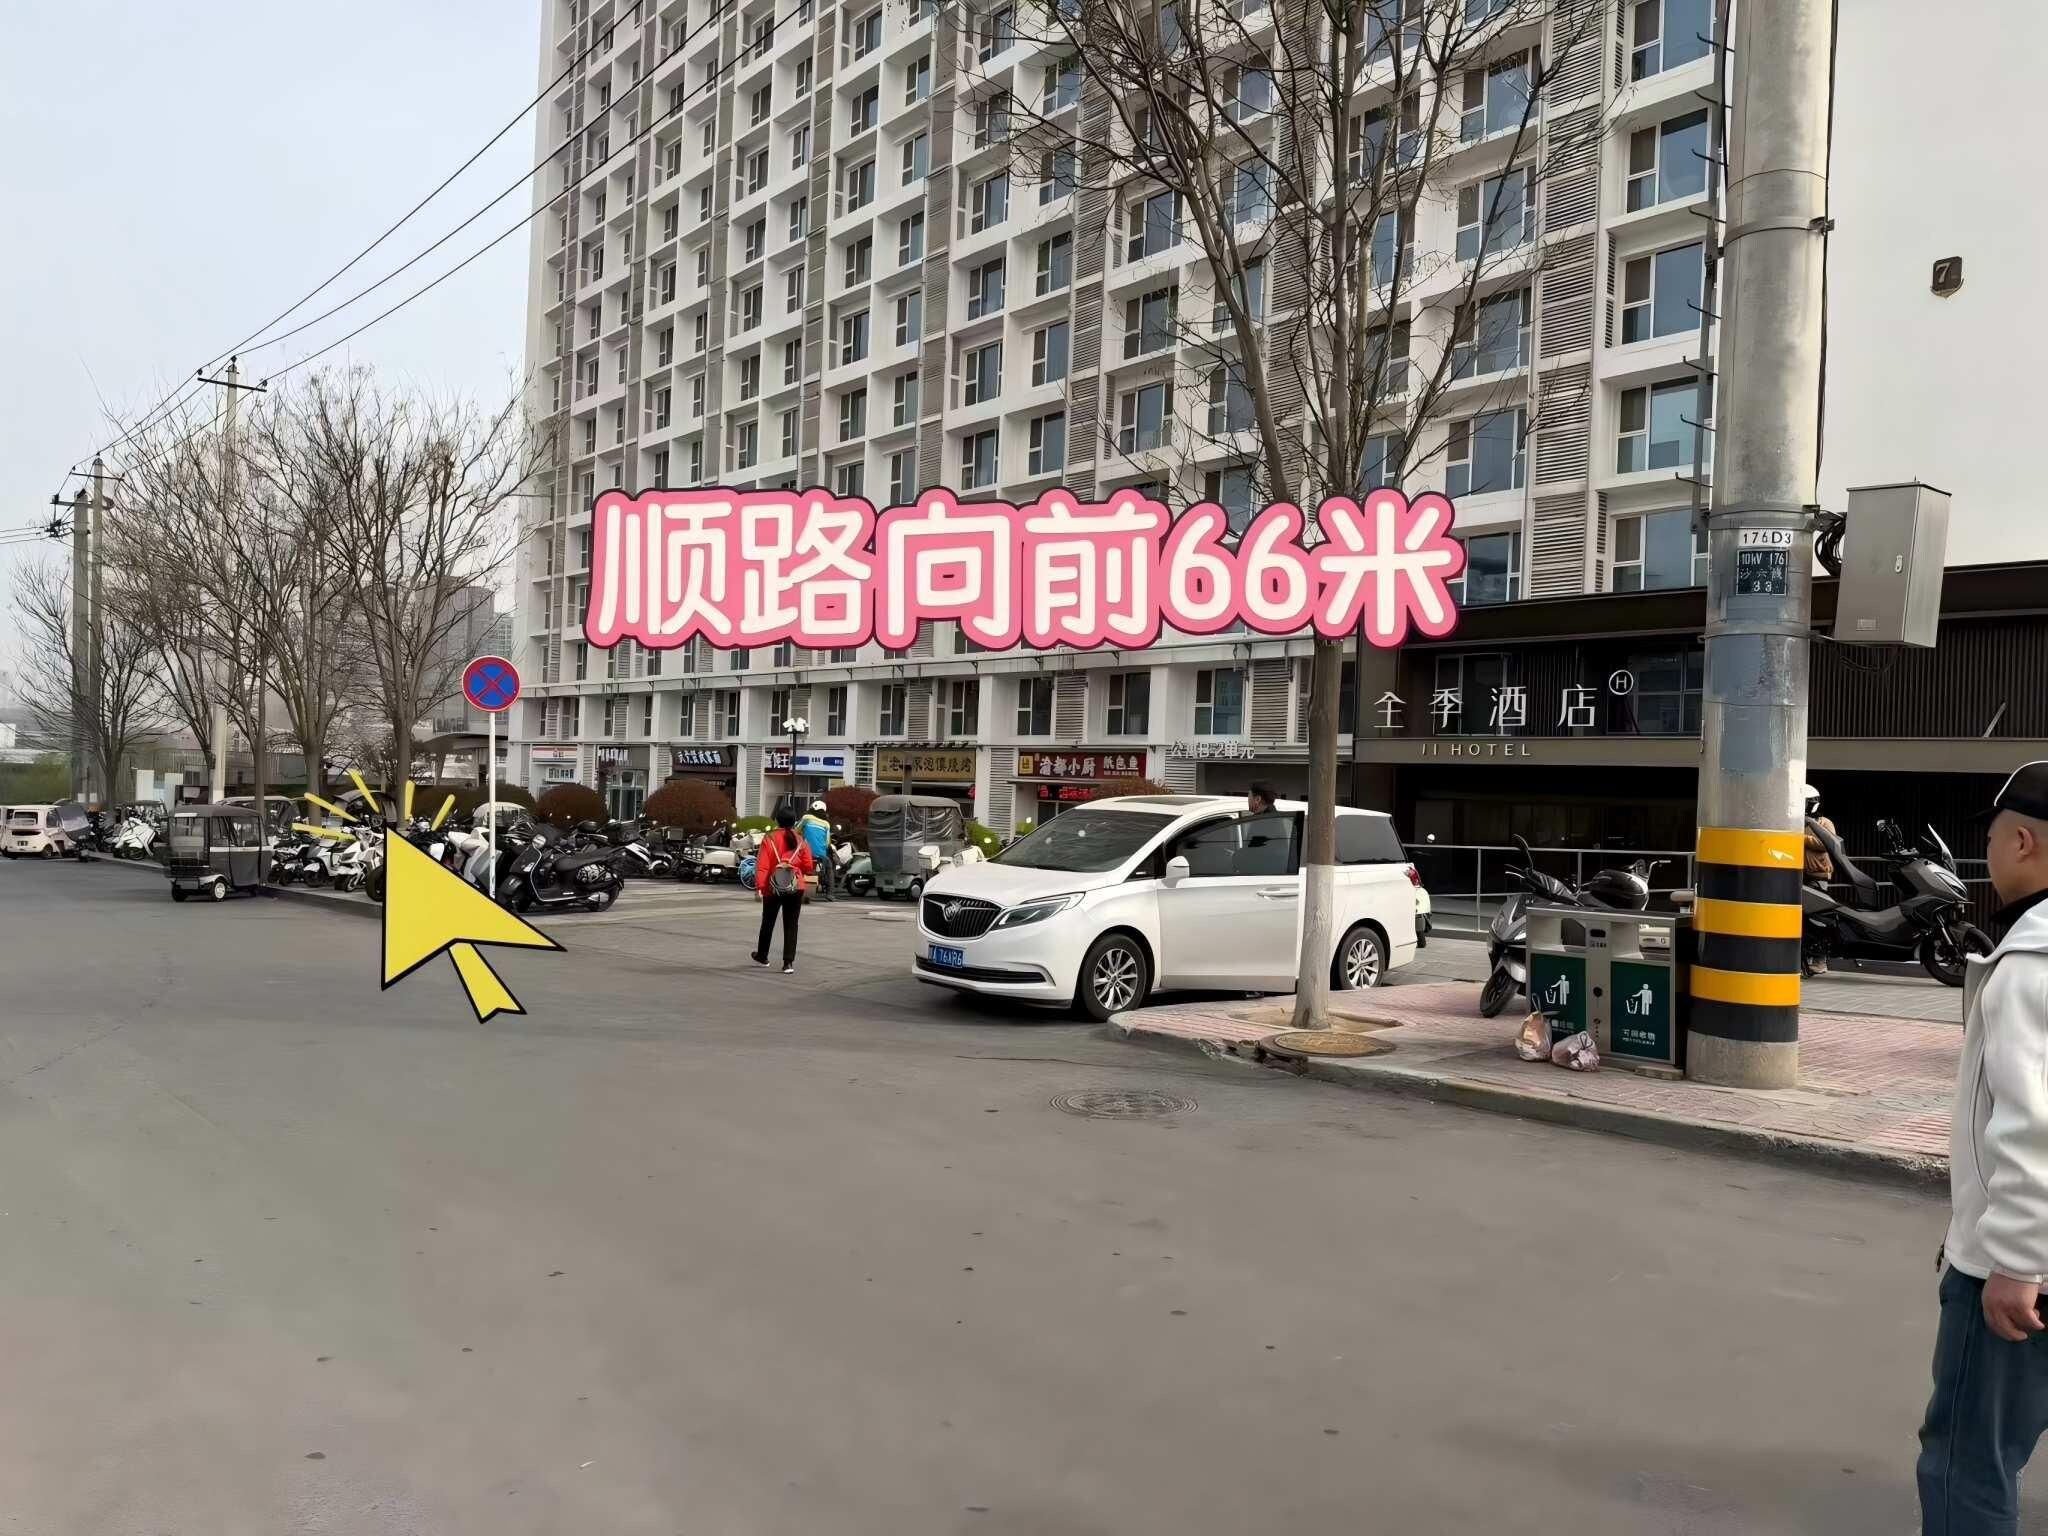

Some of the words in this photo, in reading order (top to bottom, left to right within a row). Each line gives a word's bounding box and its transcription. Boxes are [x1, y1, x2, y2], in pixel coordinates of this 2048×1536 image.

[1743, 530, 1792, 545] 176D3
[1373, 684, 1598, 728] 全季酒店
[1450, 743, 1531, 756] HOTEL
